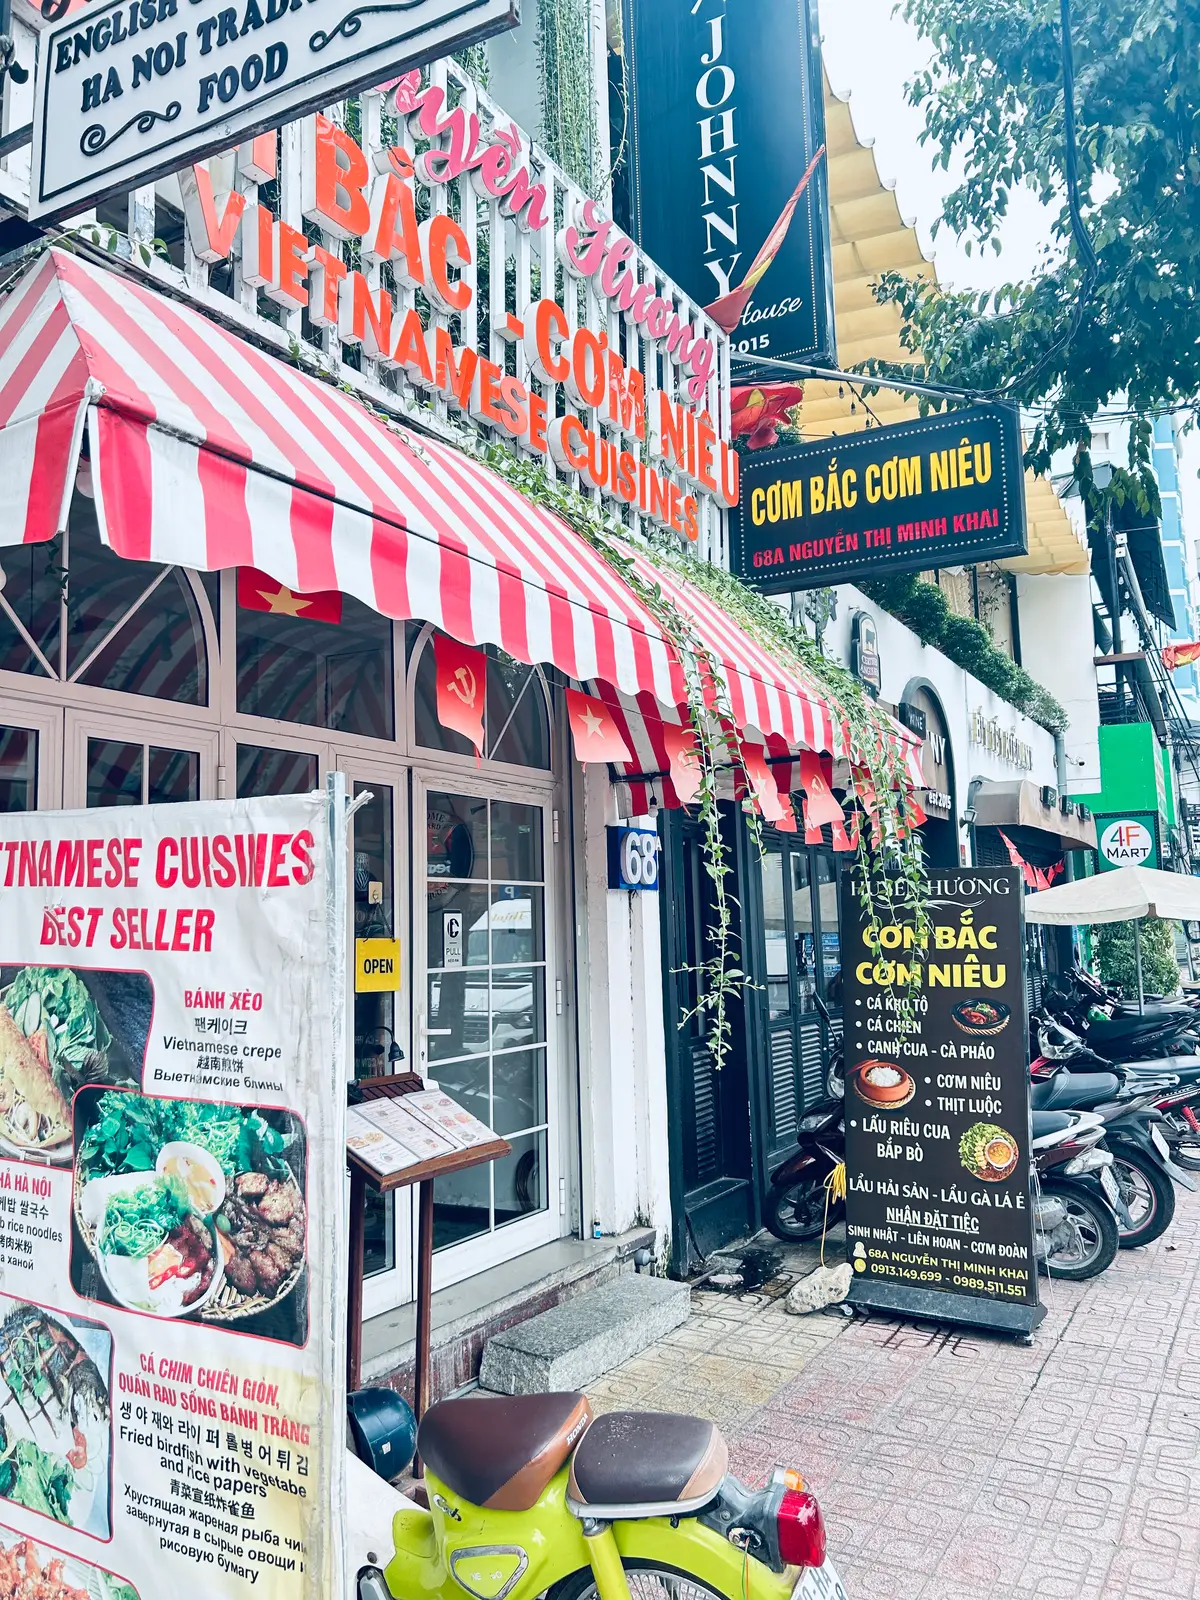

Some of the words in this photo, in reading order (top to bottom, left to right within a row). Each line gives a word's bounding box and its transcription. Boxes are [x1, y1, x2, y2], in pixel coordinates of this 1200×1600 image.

[80, 69, 123, 113] HA
[132, 31, 187, 88] NOI
[197, 41, 288, 113] FOOD
[695, 14, 743, 301] JOHNNY
[193, 160, 548, 453] VIETNAMESE
[561, 414, 698, 541] CUISINES
[536, 298, 645, 441] CƠM
[660, 390, 740, 507] NIÊU
[751, 479, 802, 526] CƠM
[810, 457, 857, 515] BẮC
[865, 455, 922, 504] CƠM
[930, 437, 992, 492] NIÊU
[753, 547, 785, 568] 68A
[789, 528, 858, 562] NGUYỄN
[863, 526, 892, 550] THỊ
[897, 517, 947, 542] MINH
[953, 508, 999, 533] KHAI
[1110, 825, 1141, 847] 4F
[0, 837, 142, 888] TNAMESE
[1107, 847, 1149, 859] MART
[927, 876, 1010, 897] HƯƠNG
[40, 905, 104, 947] BEST
[110, 907, 215, 952] SELLER
[935, 908, 997, 949] BẮC
[363, 958, 394, 974] OPEN
[446, 947, 461, 956] PULL
[928, 953, 1006, 988] NIÊU
[184, 987, 225, 1009] BÁNH
[229, 989, 262, 1011] XÈO
[867, 994, 882, 1010] CÁ
[913, 995, 928, 1015] TỘ
[194, 1017, 248, 1035] 팬케이크
[867, 1015, 883, 1031] CÁ
[163, 1036, 238, 1055] Vietnamese
[242, 1046, 282, 1061] crepe
[196, 1055, 244, 1073] 越南煎饼
[903, 1042, 928, 1056] CUA
[940, 1041, 957, 1058] CÀ
[961, 1041, 995, 1060] PHÁO
[244, 1076, 283, 1091] блины
[937, 1074, 967, 1090] CƠM
[970, 1072, 1001, 1091] NIÊU
[937, 1096, 965, 1115] THỊT
[969, 1095, 1002, 1118] LUỘC
[890, 1116, 920, 1138] RIÊU
[923, 1123, 951, 1140] CUA
[876, 1136, 902, 1160] BẮP
[906, 1142, 924, 1163] BÒ
[15, 1172, 28, 1193] HÀ
[32, 1176, 51, 1200] NỘI
[849, 1172, 873, 1193] LẨU
[877, 1178, 899, 1197] HẢI
[902, 1181, 929, 1200] SẢN
[941, 1183, 967, 1204] LẨU
[972, 1188, 991, 1208] GÀ
[995, 1190, 1013, 1209] LÁ
[1016, 1191, 1026, 1209] É
[20, 1200, 49, 1220] 쌀국수
[886, 1204, 921, 1226] NHẬN
[924, 1209, 948, 1230] ĐẶT
[951, 1211, 979, 1234] TIỆC
[8, 1218, 24, 1233] rice
[26, 1225, 63, 1243] noodles
[848, 1224, 870, 1238] SINH
[873, 1227, 898, 1244] NHẬT
[908, 1231, 930, 1247] LIÊN
[933, 1235, 961, 1251] HOAN
[971, 1241, 996, 1256] CƠM
[998, 1242, 1028, 1259] ĐOÀN
[7, 1256, 33, 1270] ханой
[868, 1248, 889, 1260] 68A
[891, 1252, 938, 1267] NGUYỄN
[941, 1258, 960, 1272] THỊ
[964, 1262, 995, 1276] MINH
[999, 1267, 1028, 1281] KHAI
[871, 1263, 942, 1282] 0913.149.699
[953, 1275, 1026, 1297] 0989.511.551
[140, 1351, 155, 1375] CÁ
[159, 1358, 193, 1385] CHIM
[197, 1367, 239, 1396] CHIÊN
[153, 1383, 177, 1407] RAU
[181, 1388, 217, 1419] SỐNG
[220, 1401, 258, 1432] BÁNH
[262, 1415, 311, 1446] TRÁNG
[566, 1412, 588, 1446] HONDA
[120, 1425, 153, 1447] Fried
[157, 1436, 203, 1466] birdfish
[207, 1456, 240, 1473] with
[160, 1456, 183, 1473] and
[187, 1465, 209, 1483] rice
[214, 1476, 267, 1498] papers
[124, 1483, 186, 1516] Хрустящая
[189, 1509, 238, 1536] жареная
[242, 1527, 279, 1547] рыба
[170, 1478, 255, 1520] 青菜宣纸炸雀鱼
[126, 1504, 189, 1537] завернутая
[193, 1528, 201, 1540] в
[204, 1532, 243, 1557] сырые
[248, 1550, 295, 1571] овощи
[159, 1537, 214, 1563] рисовую
[217, 1554, 259, 1584] бумагу
